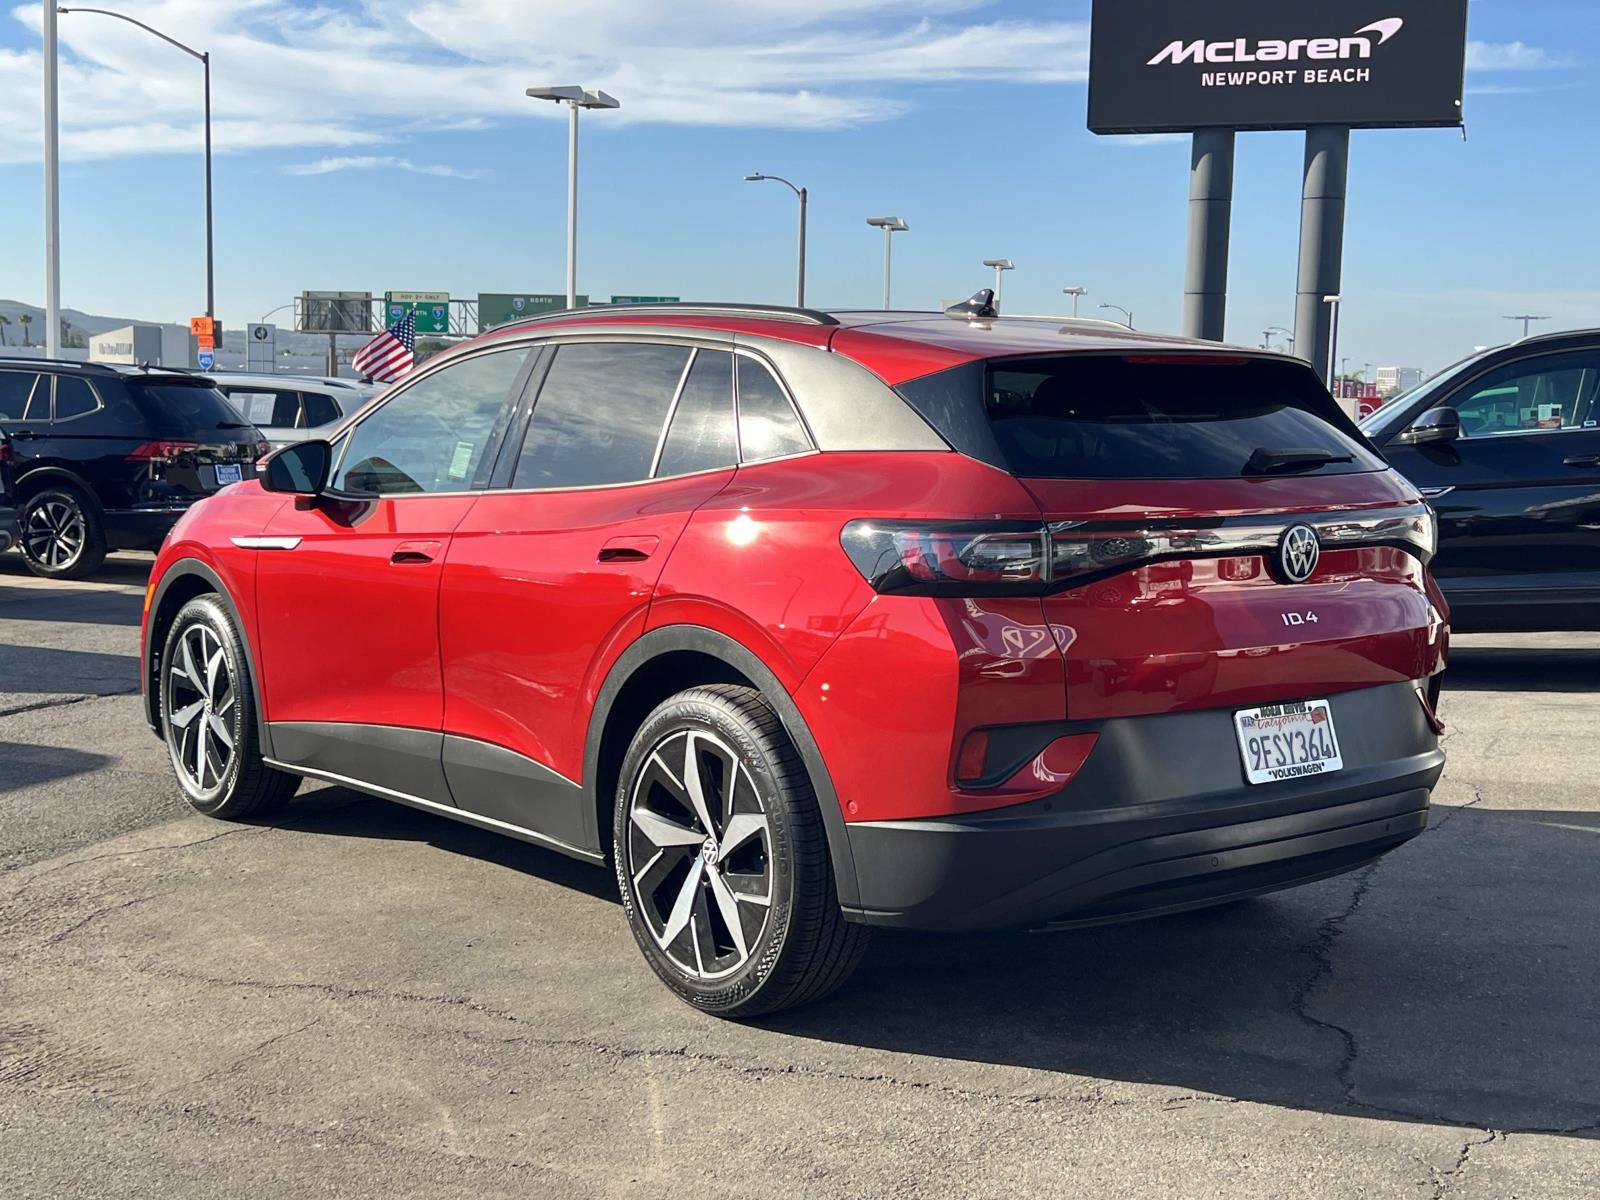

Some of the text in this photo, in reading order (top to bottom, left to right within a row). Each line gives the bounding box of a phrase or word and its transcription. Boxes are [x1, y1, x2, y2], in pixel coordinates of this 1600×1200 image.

[1146, 37, 1371, 65] McLaren
[1201, 67, 1371, 87] NEWPORT BEACH
[1249, 727, 1331, 770] 9FSY364
[1272, 762, 1323, 780] VOLKSWAGEN
